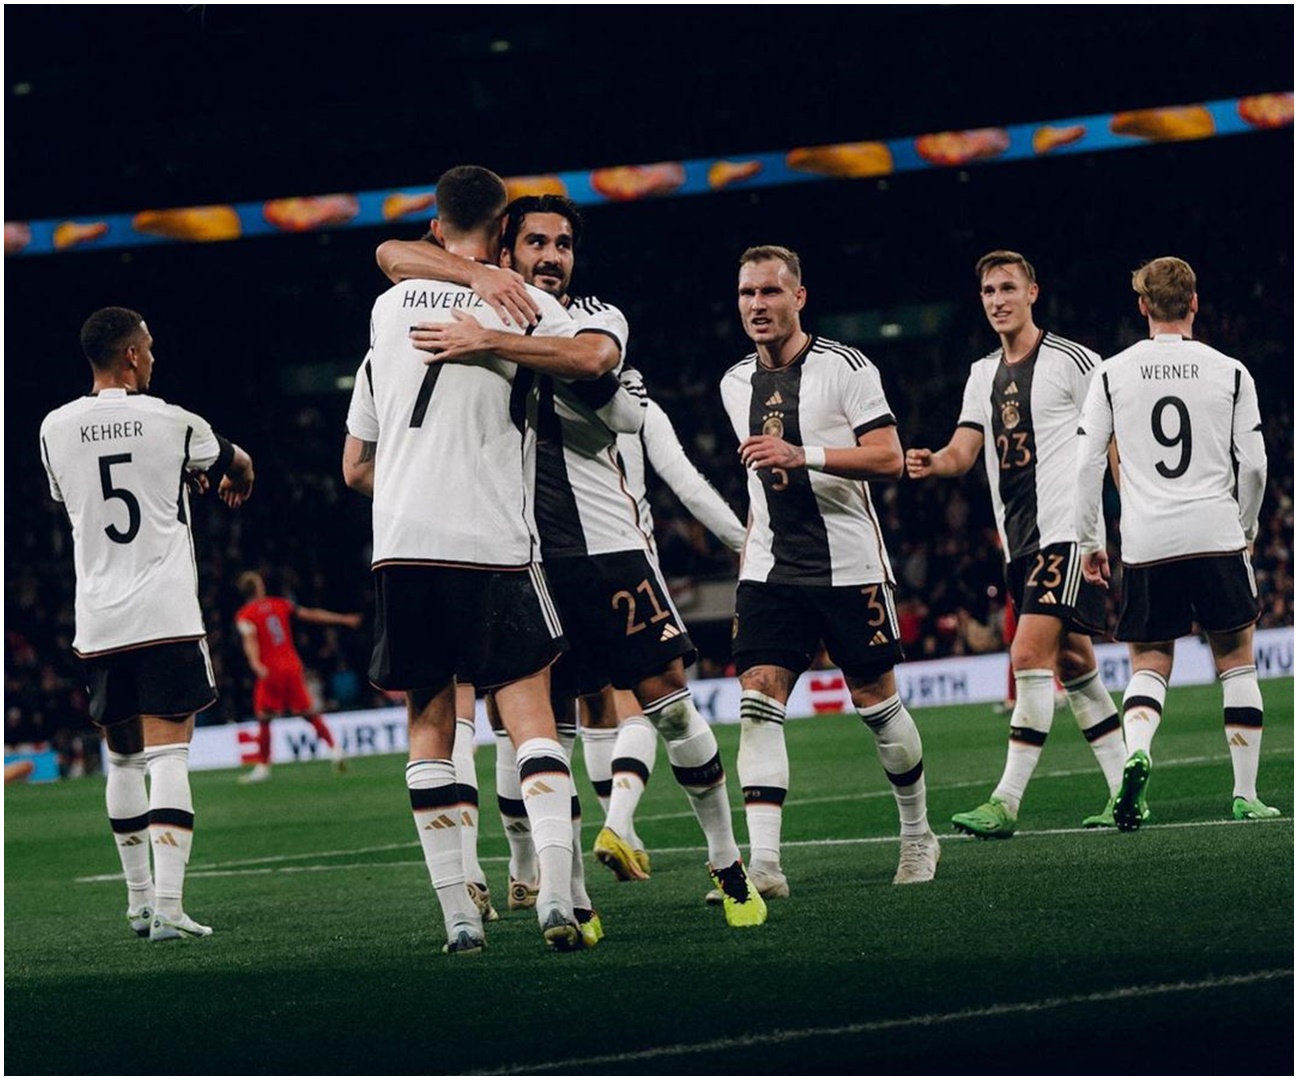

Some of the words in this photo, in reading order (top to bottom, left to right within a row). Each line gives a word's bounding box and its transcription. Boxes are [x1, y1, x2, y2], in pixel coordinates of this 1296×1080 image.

[1140, 364, 1199, 381] WERNER
[80, 421, 144, 443] KEHRER
[997, 432, 1032, 469] 23
[1151, 395, 1193, 479] 9
[98, 453, 141, 544] 5
[1026, 554, 1064, 588] 23
[611, 578, 671, 637] 21
[861, 585, 886, 627] 3
